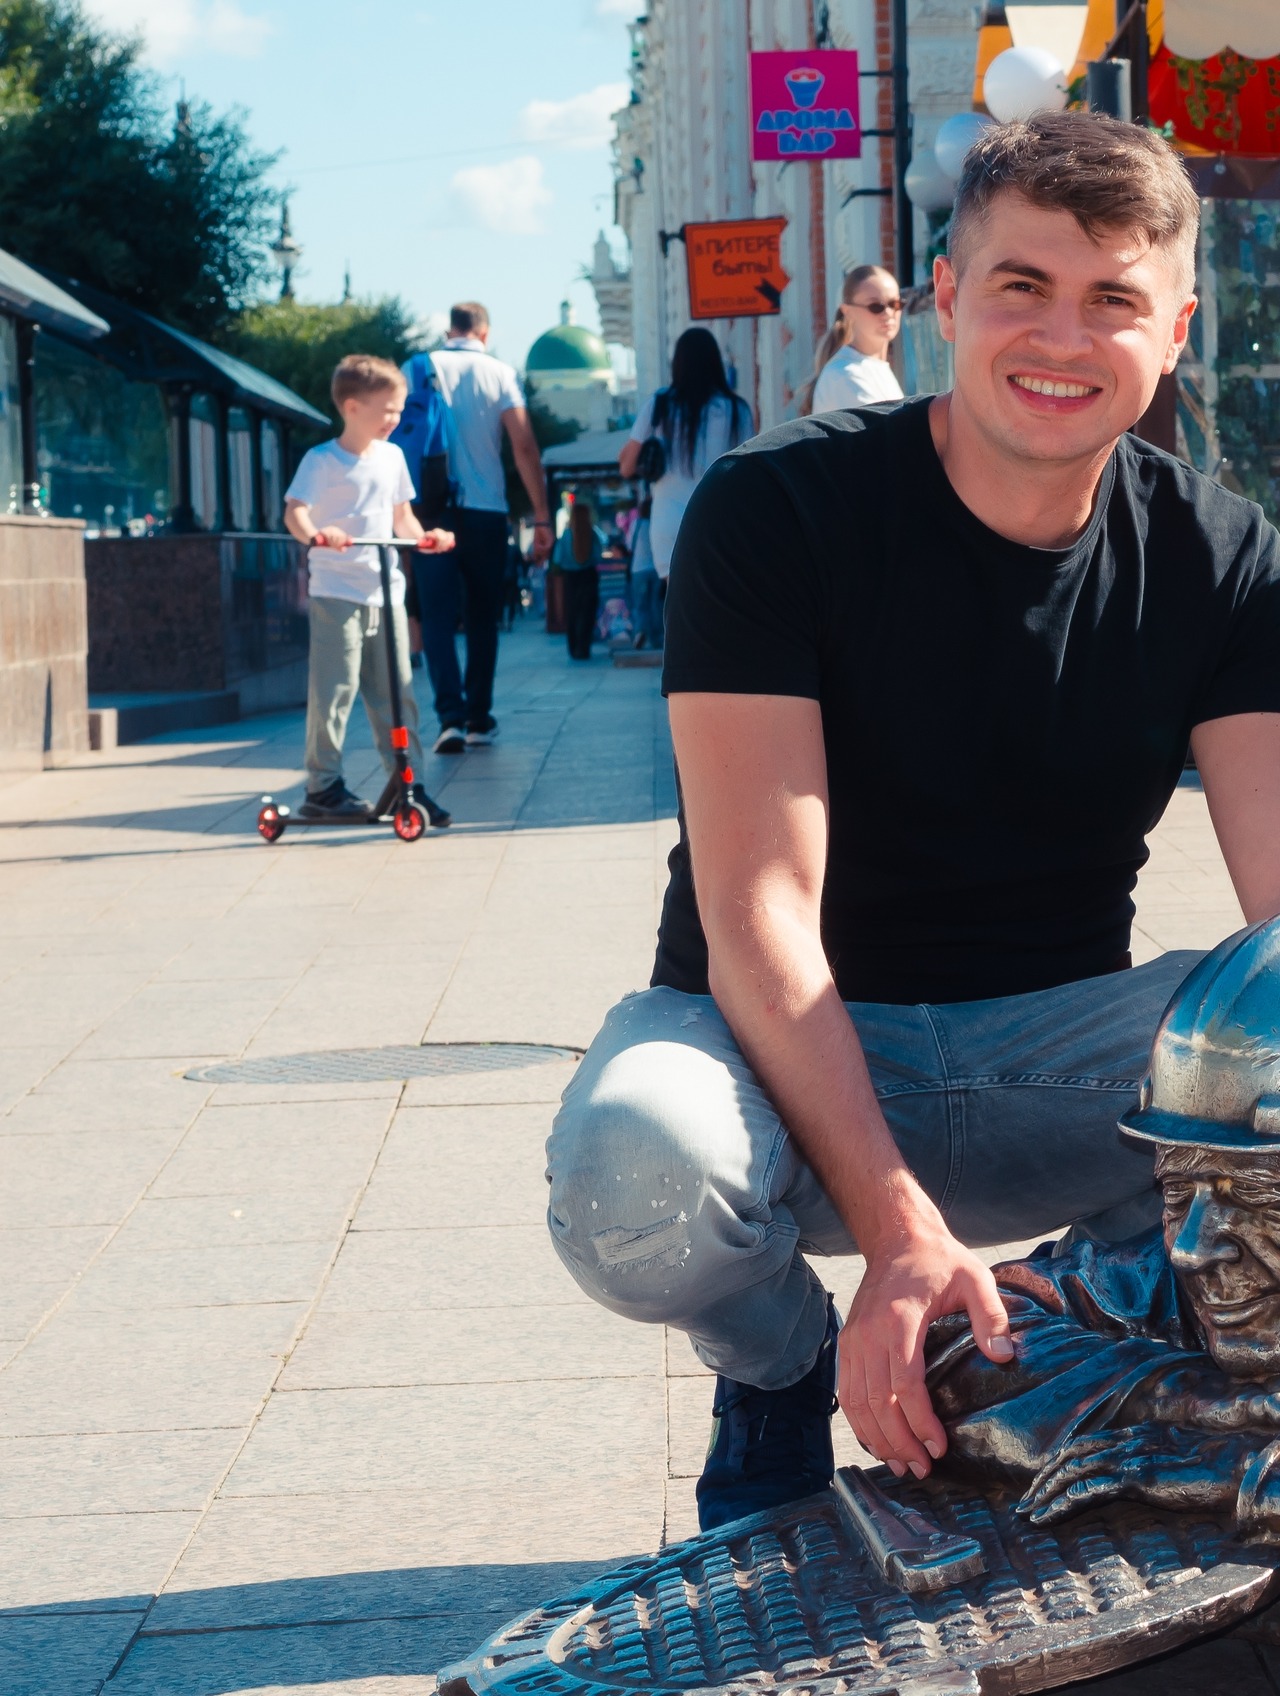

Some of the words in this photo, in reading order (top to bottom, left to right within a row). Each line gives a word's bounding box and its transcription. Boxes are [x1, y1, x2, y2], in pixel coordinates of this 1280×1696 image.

[757, 109, 856, 131] АРОМА
[777, 131, 836, 153] БАР
[705, 235, 780, 254] ПИТЕРЕ
[712, 256, 773, 277] быть!
